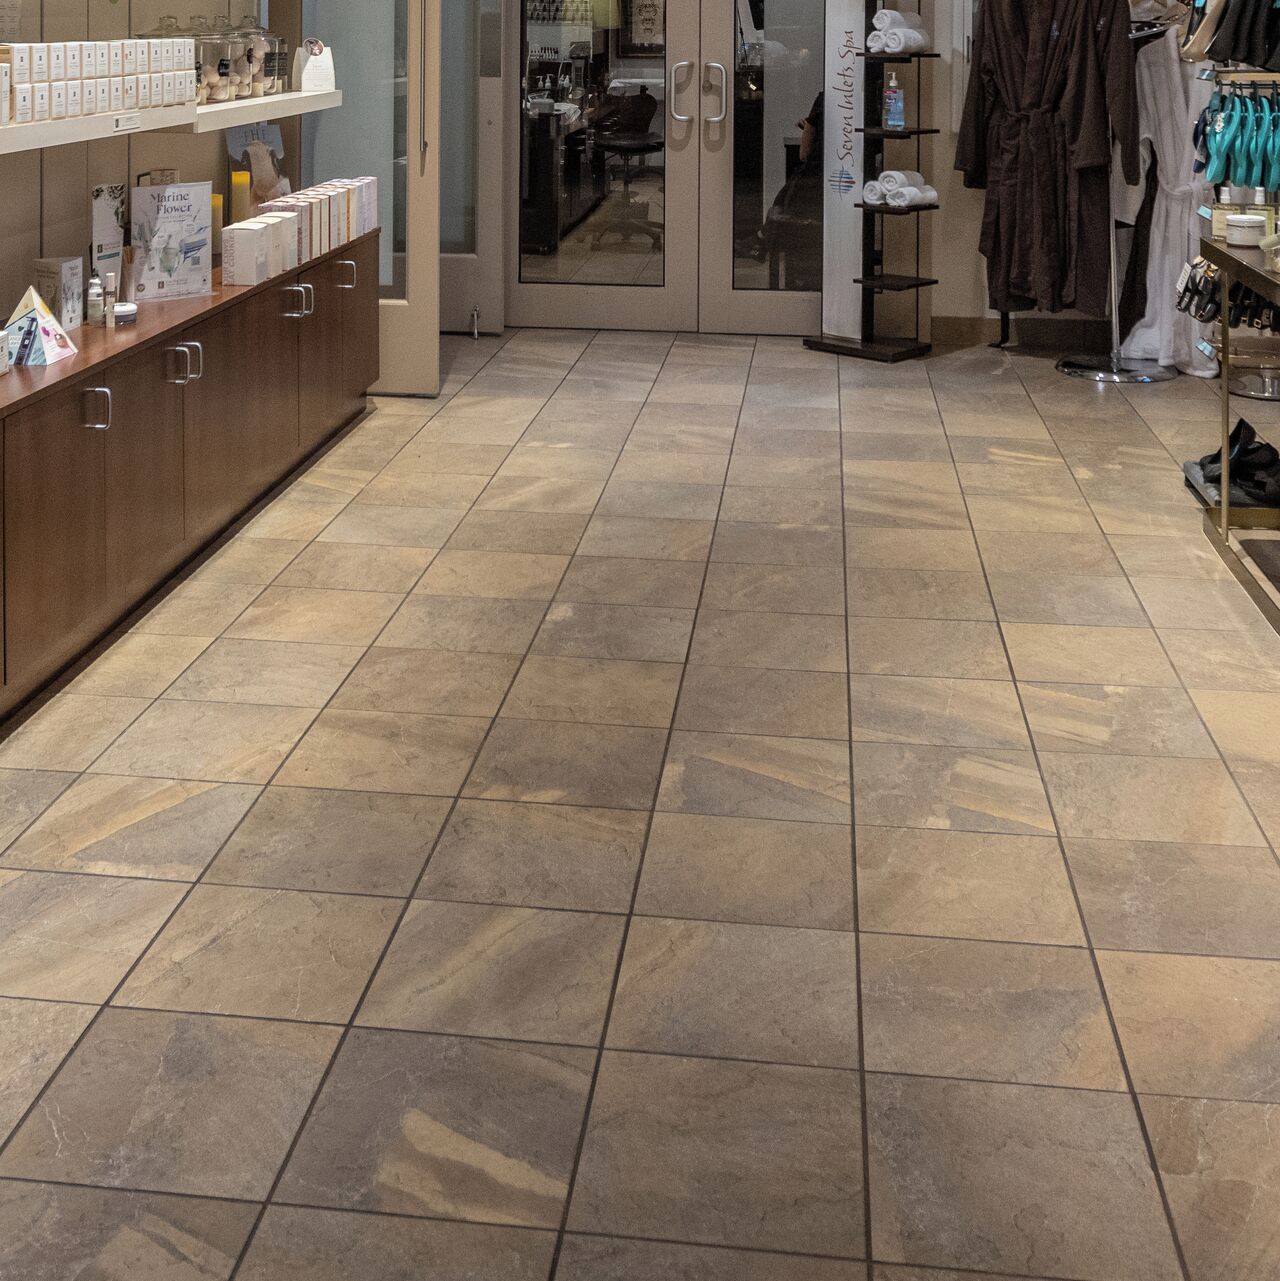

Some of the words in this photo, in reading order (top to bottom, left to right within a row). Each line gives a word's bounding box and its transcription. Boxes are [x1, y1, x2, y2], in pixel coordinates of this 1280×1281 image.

[838, 30, 864, 65] Spa
[832, 66, 856, 110] Inlets
[836, 115, 856, 168] Seven
[150, 191, 190, 204] Marine
[156, 203, 193, 215] Flower
